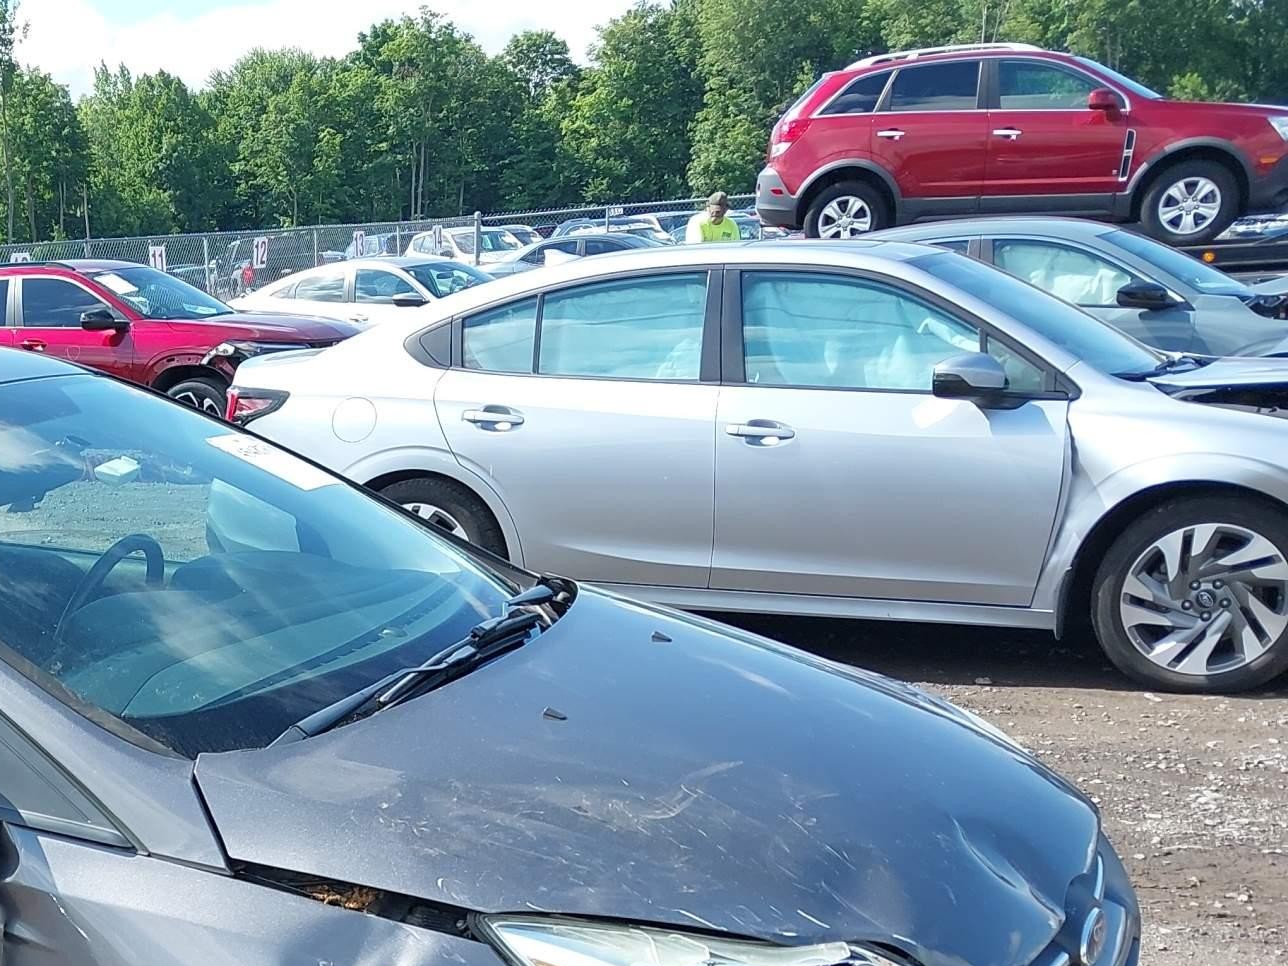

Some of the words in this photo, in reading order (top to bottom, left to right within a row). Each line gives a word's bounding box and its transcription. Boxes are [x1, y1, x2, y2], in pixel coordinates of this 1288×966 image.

[355, 233, 364, 256] 13
[433, 227, 442, 248] 14
[152, 249, 163, 271] 11
[255, 241, 266, 265] 12
